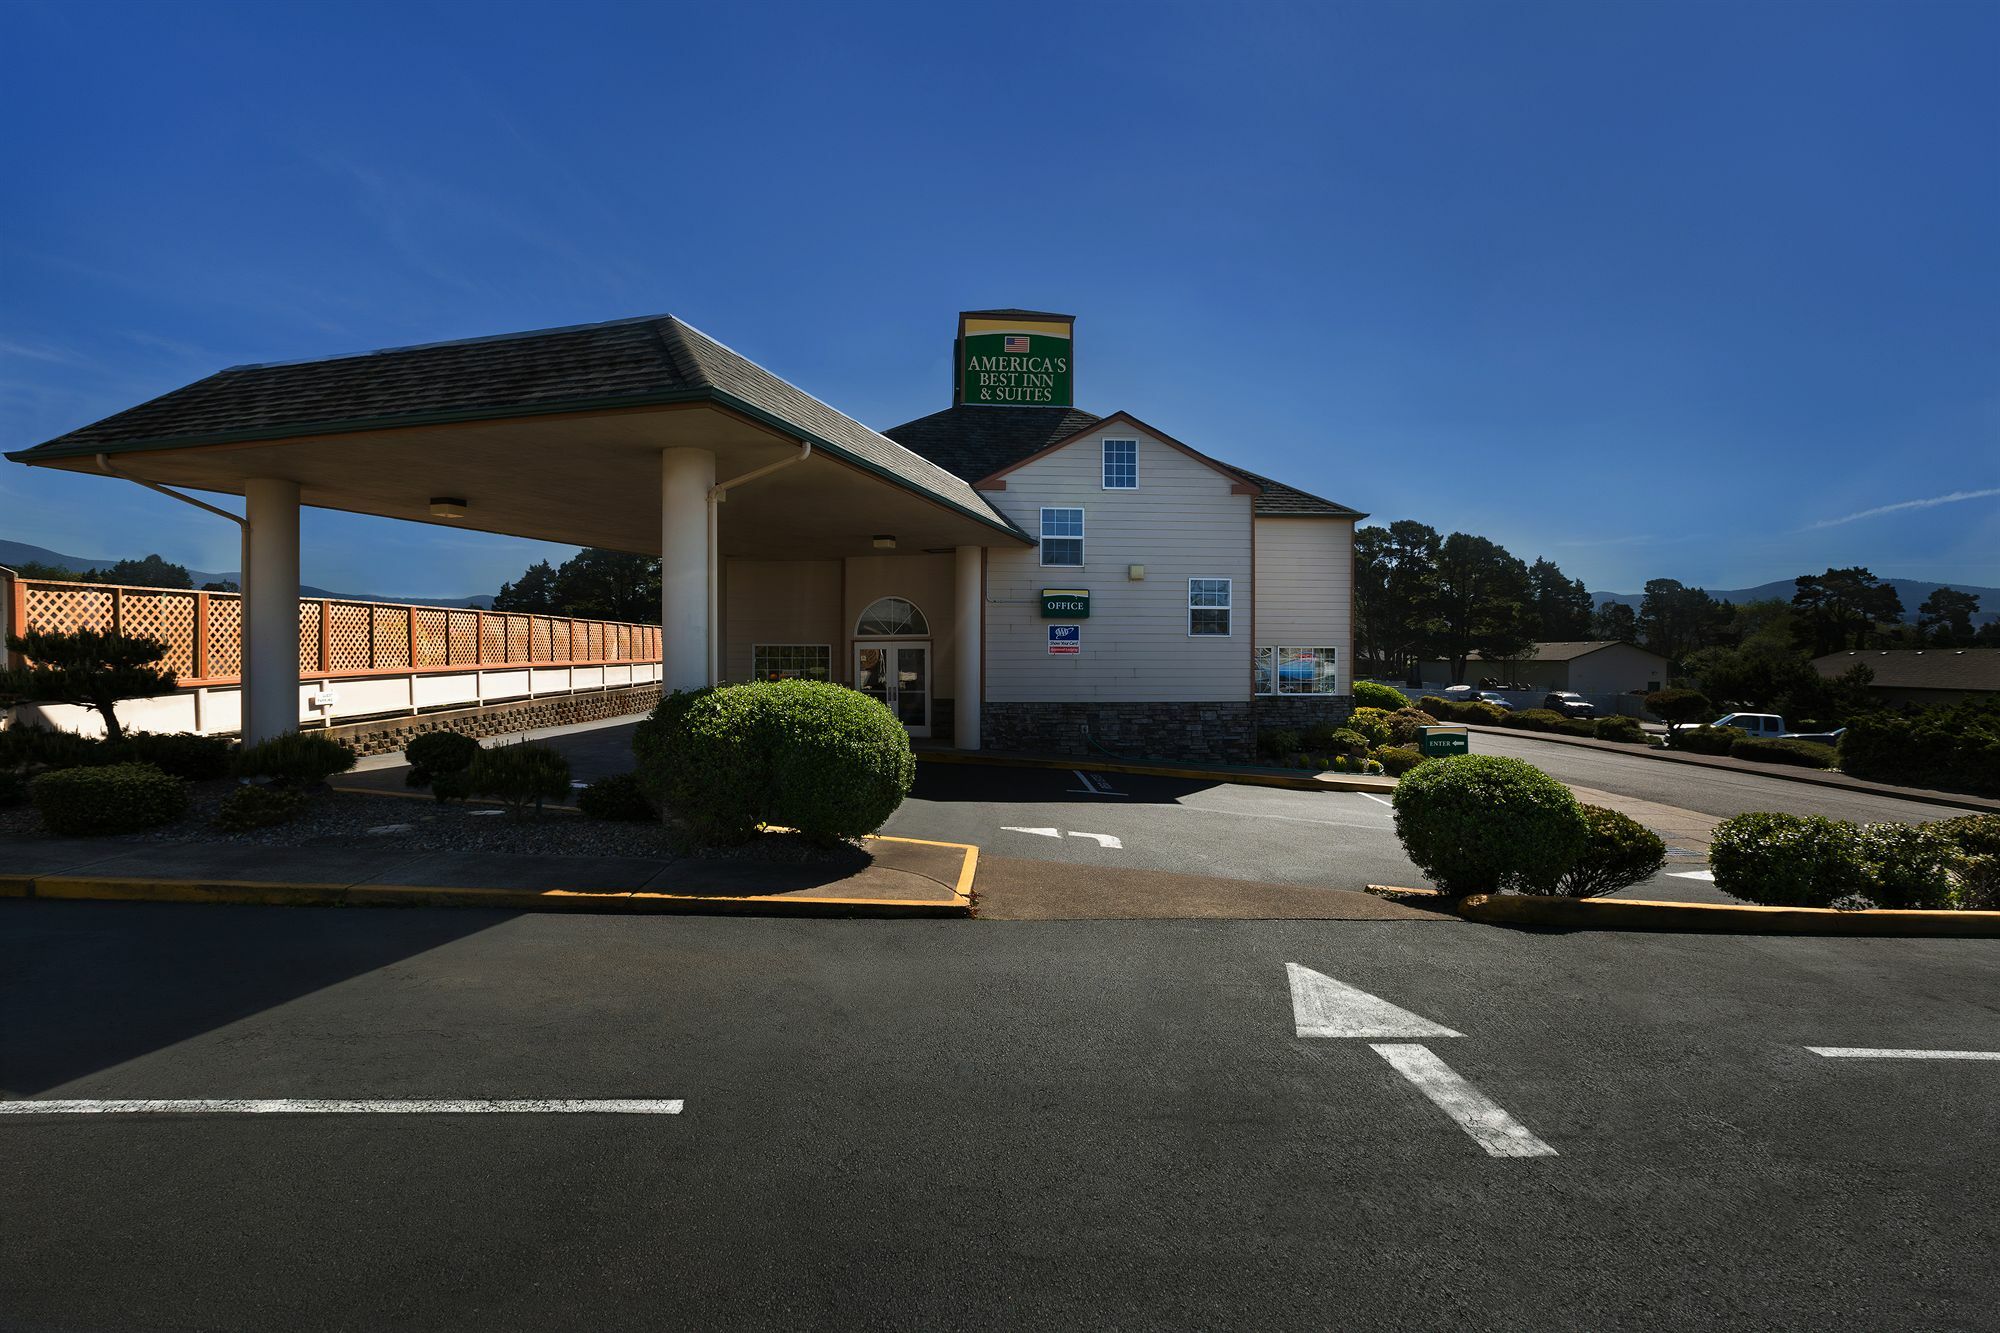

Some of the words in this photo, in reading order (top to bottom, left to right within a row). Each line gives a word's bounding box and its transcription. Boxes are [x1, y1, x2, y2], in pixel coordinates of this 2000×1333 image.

[968, 356, 1067, 373] AMERICA'S
[979, 372, 1019, 387] BEST
[1022, 373, 1054, 387] INN
[980, 387, 992, 400] &
[996, 387, 1052, 402] SUITES
[1047, 601, 1084, 610] OFFICE
